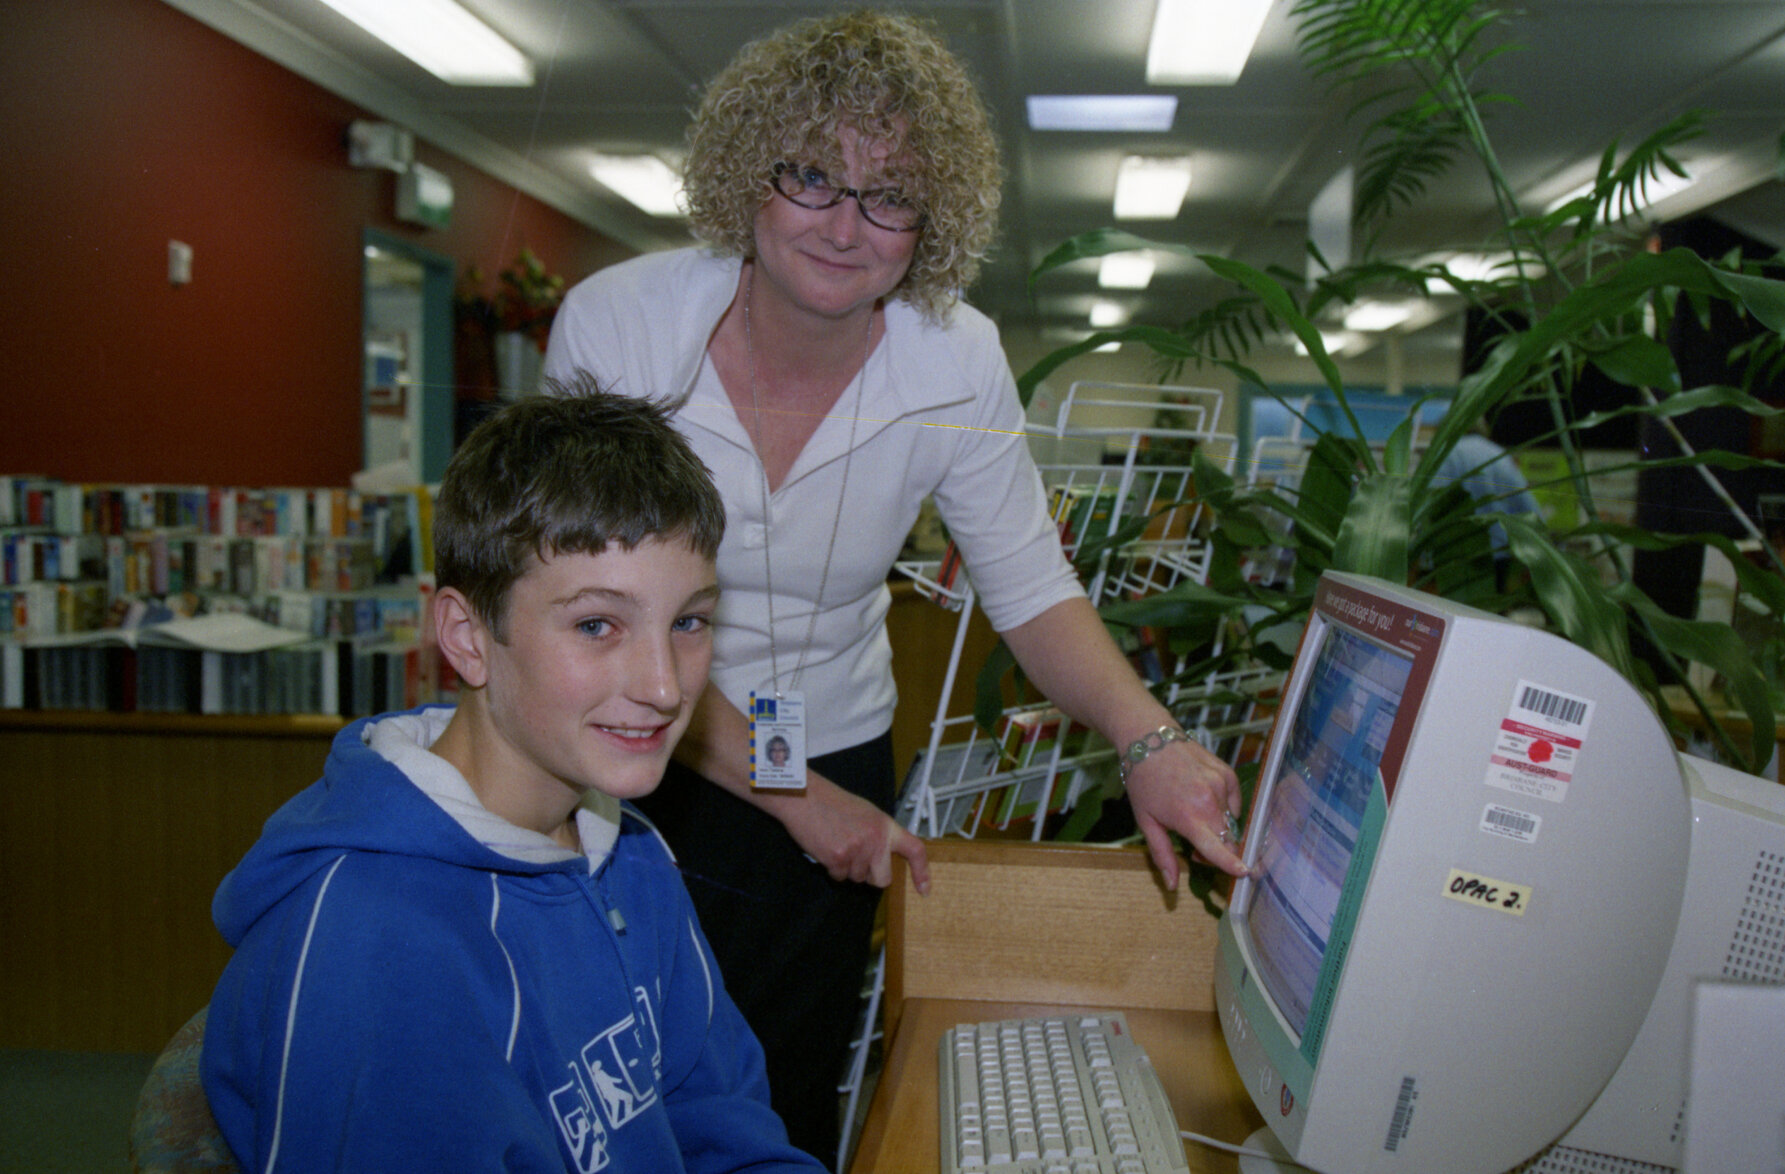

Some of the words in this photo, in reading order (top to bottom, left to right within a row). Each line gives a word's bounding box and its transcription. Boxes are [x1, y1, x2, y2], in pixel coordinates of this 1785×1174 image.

[1366, 604, 1379, 625] for
[1374, 613, 1395, 631] you!
[1505, 759, 1558, 779] AUST-GUARD
[1450, 877, 1499, 903] OPAC
